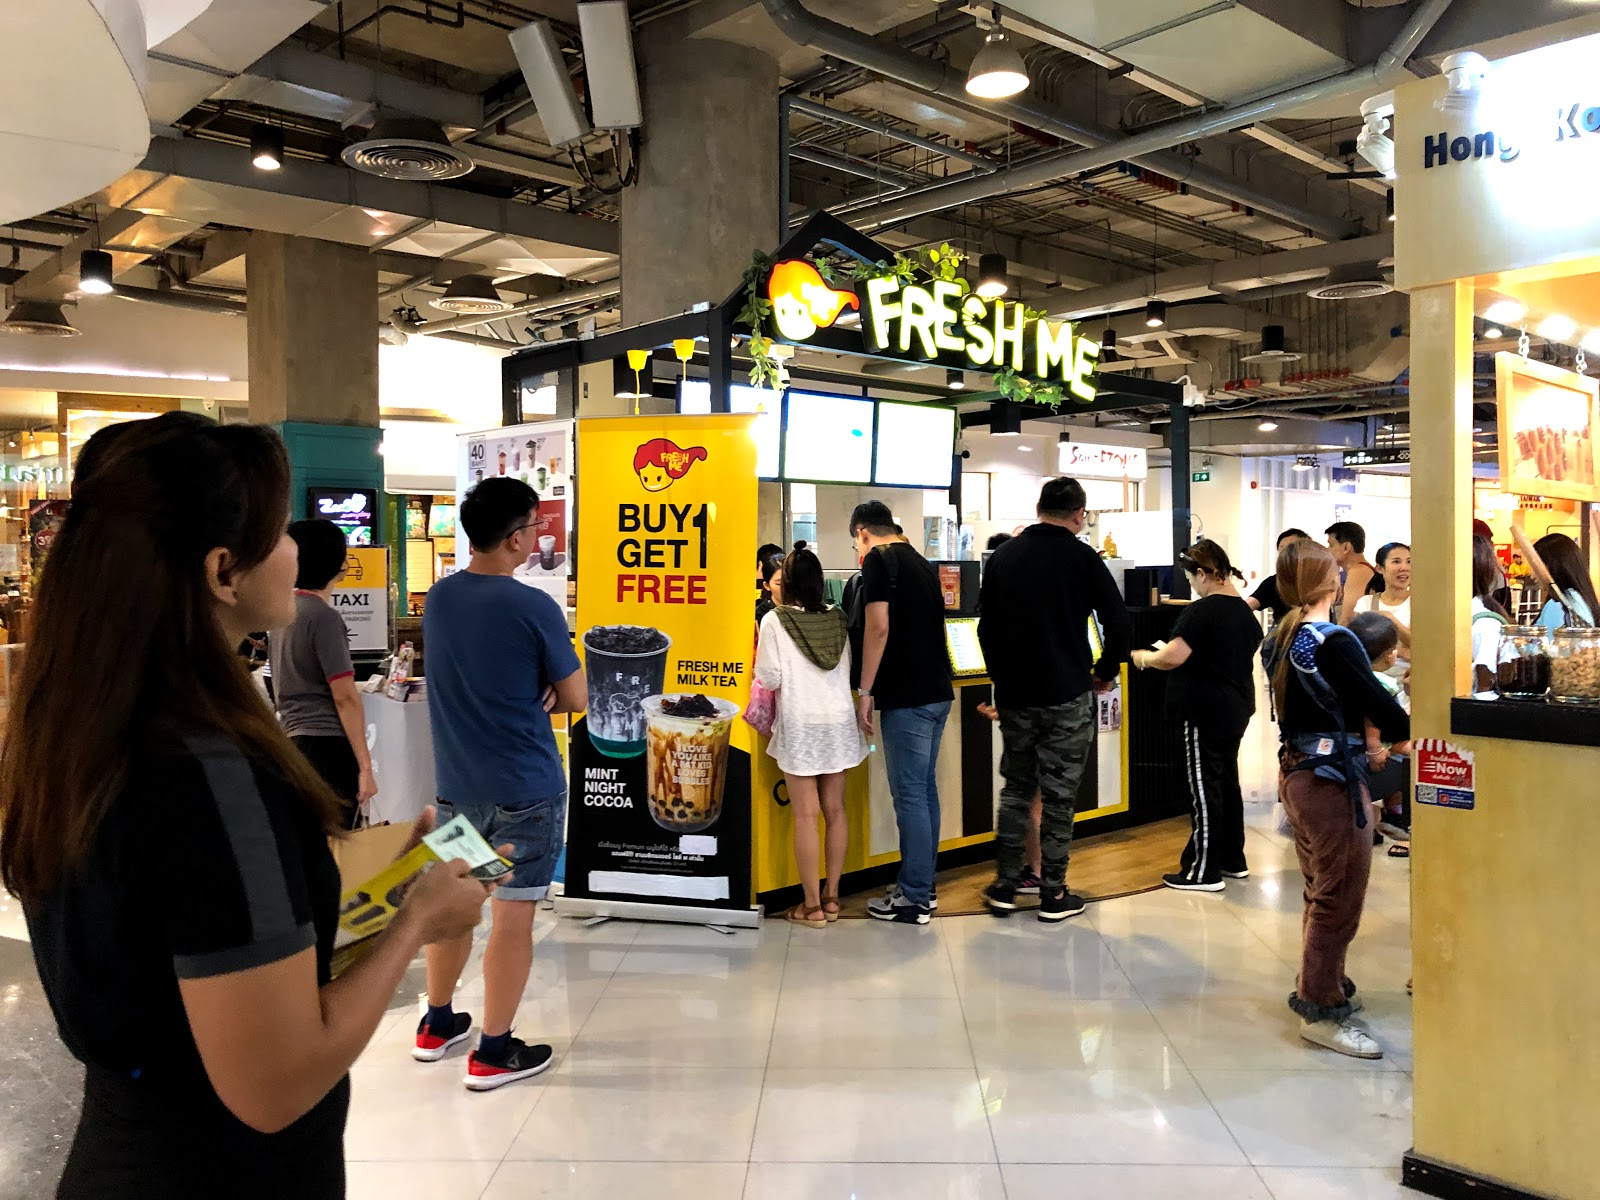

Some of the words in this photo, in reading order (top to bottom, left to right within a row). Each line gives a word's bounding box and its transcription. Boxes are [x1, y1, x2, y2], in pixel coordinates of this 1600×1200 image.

[867, 275, 1024, 371] FRESH
[1036, 317, 1100, 401] ME
[471, 444, 485, 460] 40
[660, 451, 690, 464] FRESH
[668, 461, 684, 472] ME
[618, 503, 692, 533] BUY
[693, 503, 707, 569] 1
[616, 538, 688, 568] GET
[617, 574, 707, 604] FREE
[331, 593, 370, 606] TAXI
[678, 660, 719, 673] FRESH
[723, 662, 744, 674] ME
[678, 674, 709, 686] MILK
[712, 675, 738, 687] TEA
[683, 745, 708, 753] LOVE
[672, 751, 693, 760] YOU
[694, 752, 712, 761] LIKE
[698, 761, 712, 769] KID
[1436, 762, 1468, 775] Now
[585, 767, 619, 780] MINT
[584, 782, 627, 795] NIGHT
[584, 795, 634, 809] COCOA
